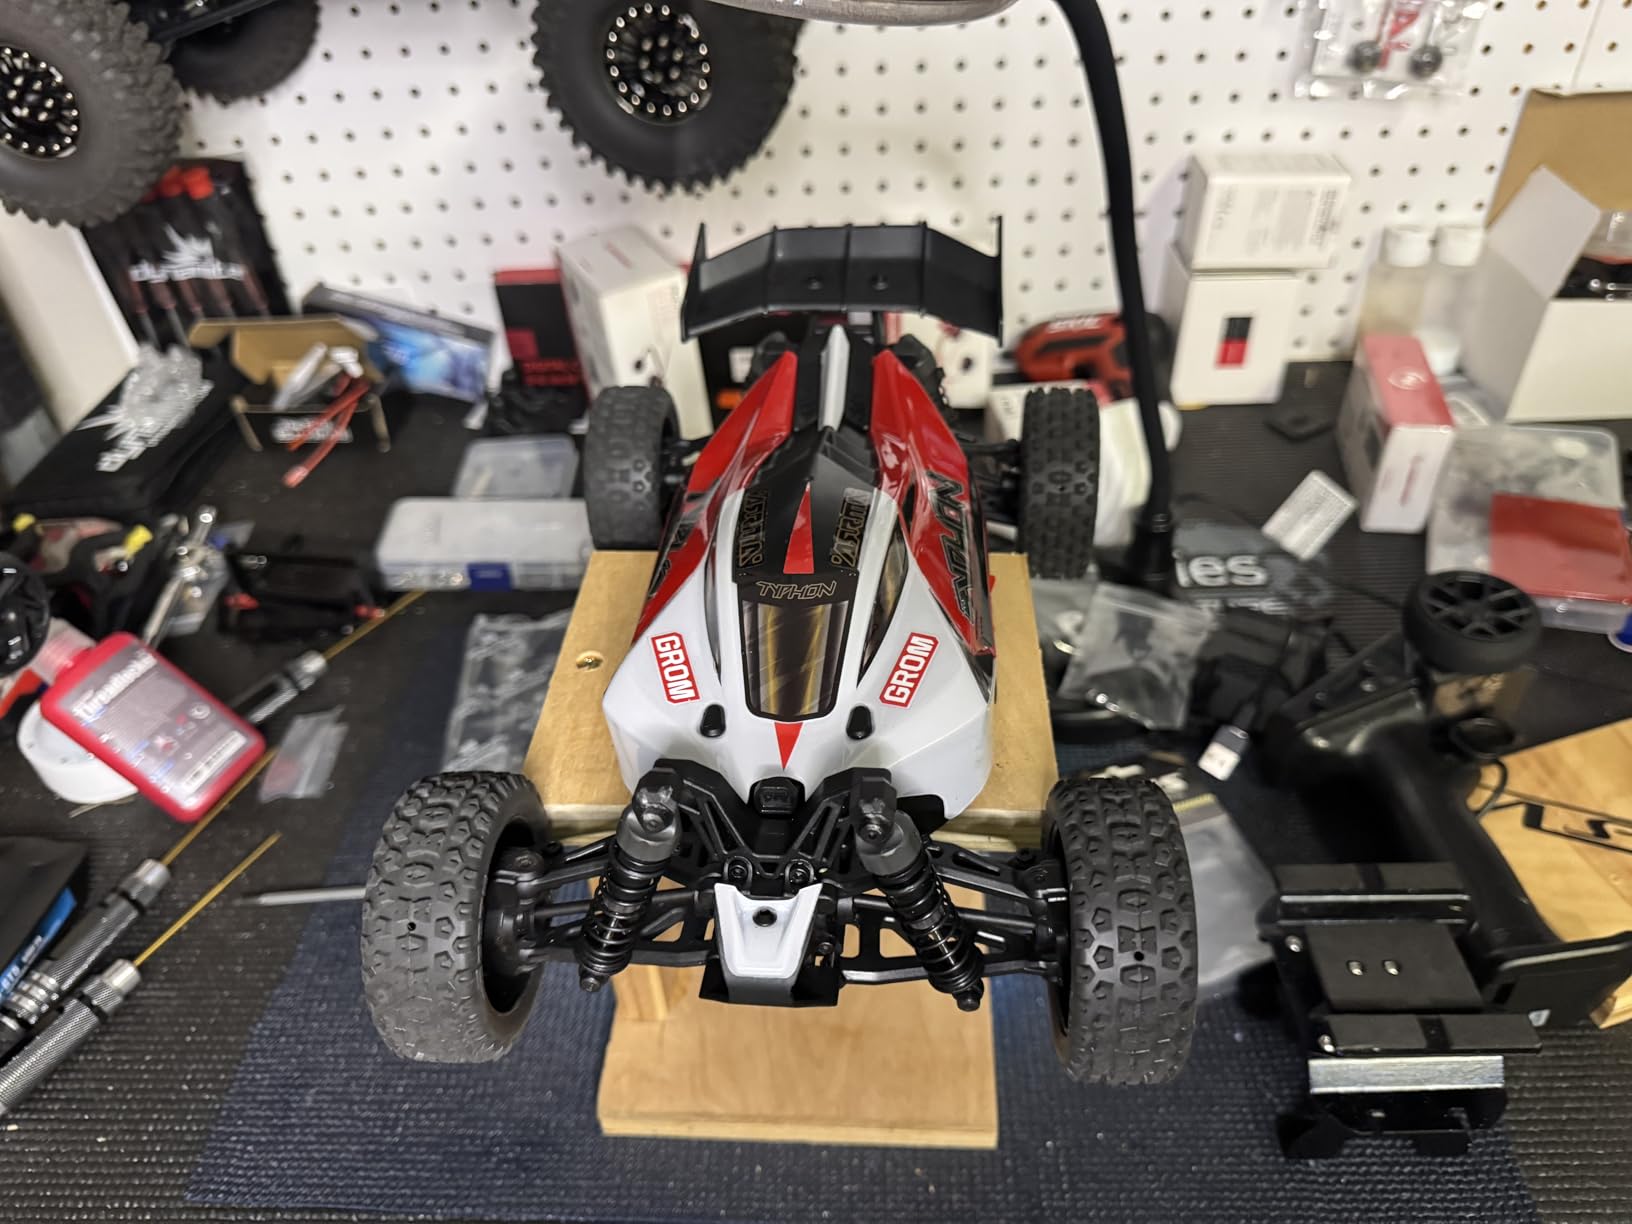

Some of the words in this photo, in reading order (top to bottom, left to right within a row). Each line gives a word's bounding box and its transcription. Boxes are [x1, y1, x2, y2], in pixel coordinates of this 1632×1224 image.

[756, 580, 838, 600] TYPHON
[654, 635, 697, 701] GROM
[882, 635, 936, 705] GROM
